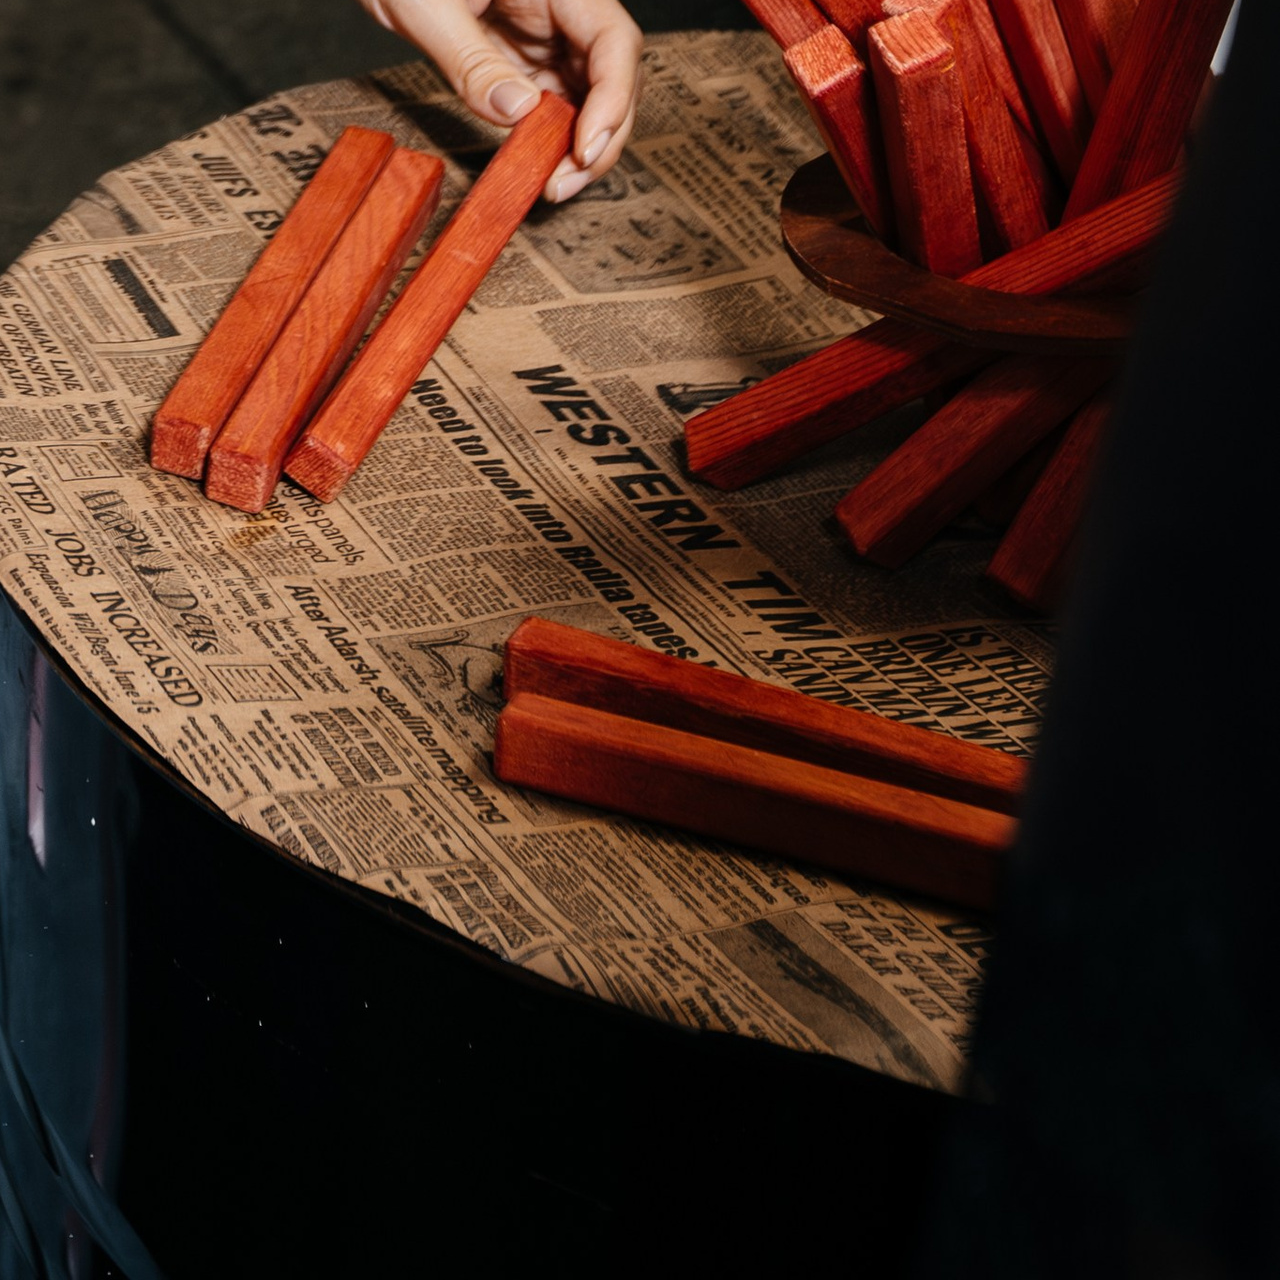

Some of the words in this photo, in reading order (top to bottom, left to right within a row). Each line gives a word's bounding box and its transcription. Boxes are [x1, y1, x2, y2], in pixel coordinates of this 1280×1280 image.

[12, 303, 62, 355] GERMAN
[51, 359, 84, 392] LINE
[411, 379, 476, 433] Need
[451, 435, 490, 457] to
[471, 459, 535, 501] look
[515, 502, 574, 543] into
[555, 545, 634, 603] Radia
[512, 363, 741, 553] WESTERN
[80, 490, 161, 555] Happy
[151, 587, 226, 656] Days
[284, 524, 336, 563] urged
[314, 519, 365, 567] panels,
[25, 551, 75, 608] Expansion
[67, 612, 102, 636] Will
[85, 634, 121, 667] Begin
[107, 667, 143, 698] June
[129, 698, 161, 715] 15
[45, 528, 104, 578] JOBS
[90, 591, 203, 708] INCREASED
[940, 625, 1001, 648] IS
[284, 584, 329, 623] After
[324, 625, 379, 685] Adarsh,
[370, 685, 437, 754] satellite
[429, 752, 512, 825] mapping
[802, 645, 870, 693] CAN
[848, 639, 973, 718] BRITAIN
[898, 633, 980, 676] ONE
[947, 678, 1041, 735] LEFT
[820, 922, 903, 977] DAKAR
